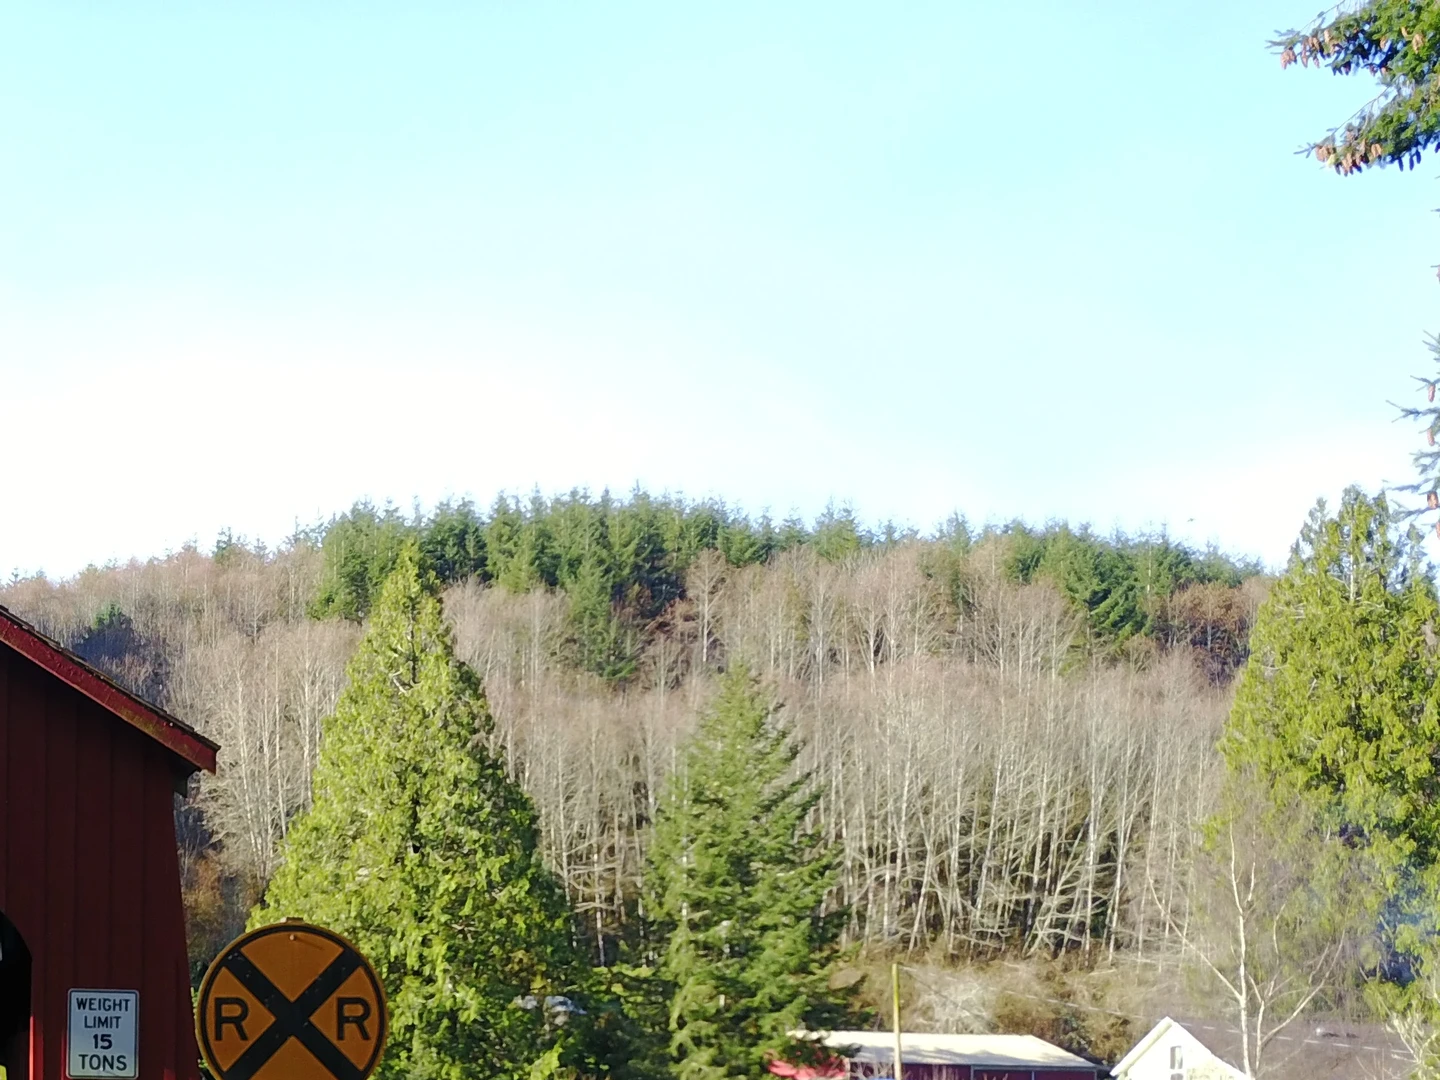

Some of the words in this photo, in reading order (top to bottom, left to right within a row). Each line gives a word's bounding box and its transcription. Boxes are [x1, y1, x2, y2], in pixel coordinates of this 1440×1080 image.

[75, 997, 131, 1012] WEIGHT
[83, 1015, 122, 1029] LIMIT
[213, 996, 249, 1042] R
[336, 996, 372, 1042] R
[92, 1033, 113, 1050] 15
[78, 1053, 128, 1072] TONS
